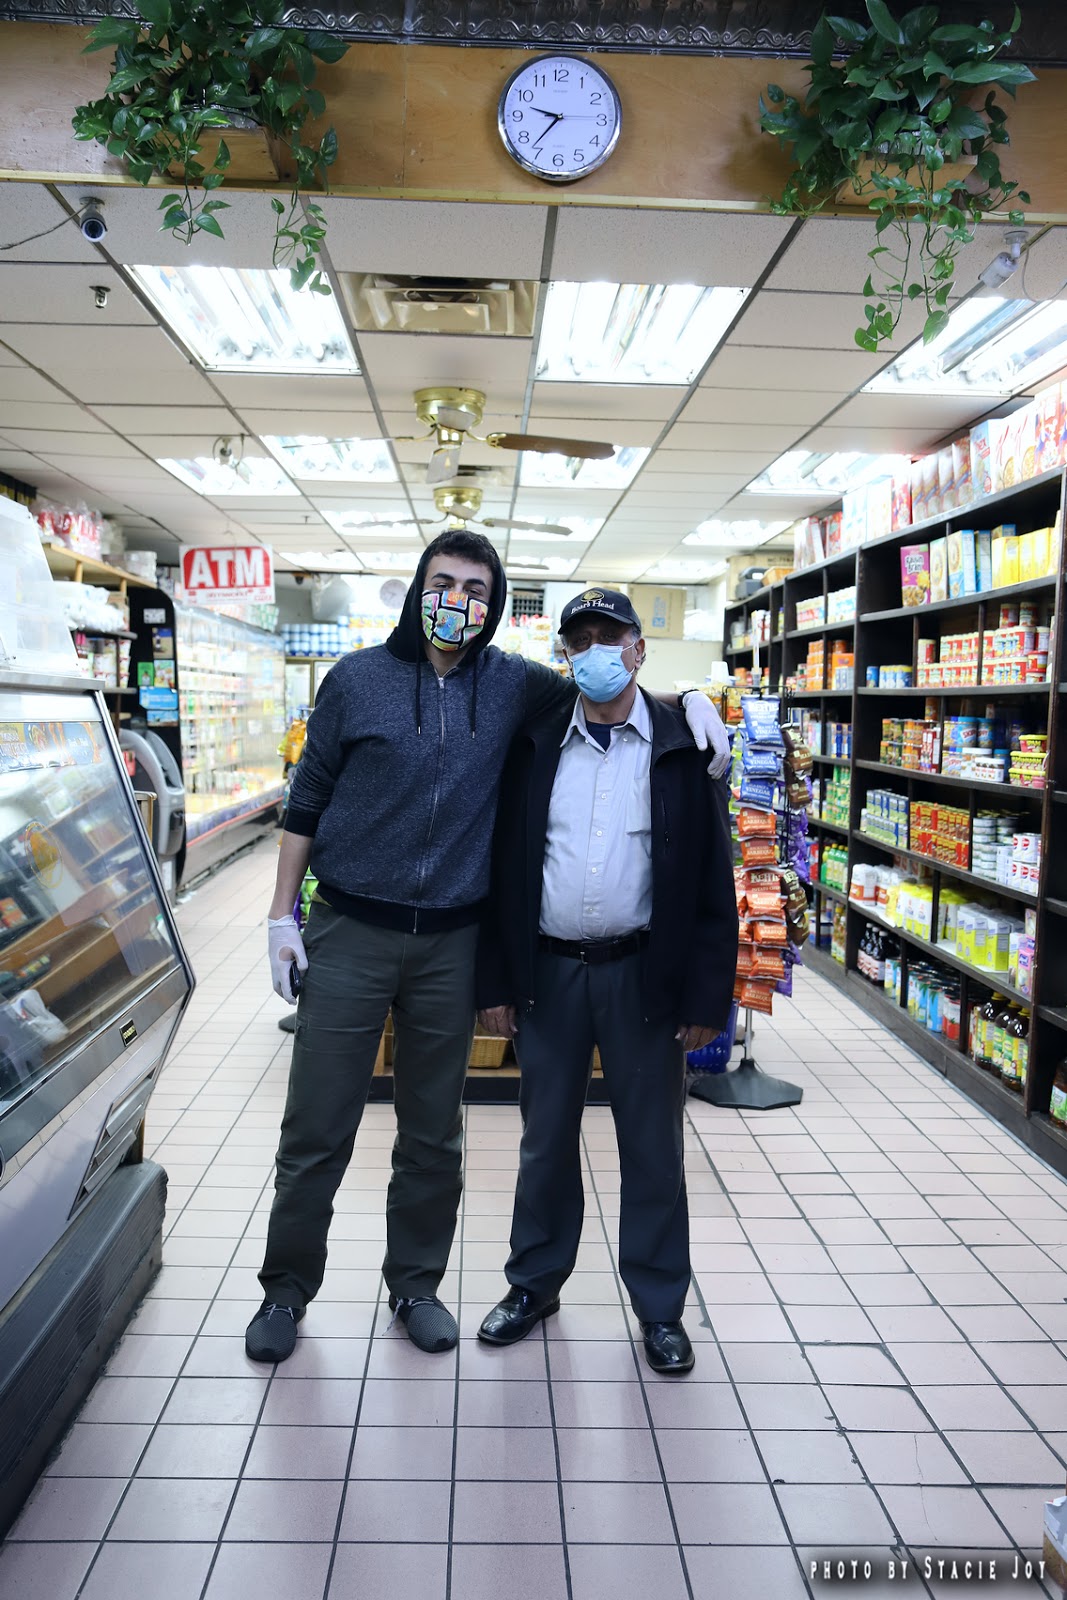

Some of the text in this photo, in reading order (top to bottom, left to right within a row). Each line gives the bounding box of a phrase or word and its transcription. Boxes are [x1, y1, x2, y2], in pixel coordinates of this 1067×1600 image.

[533, 75, 546, 87] 11
[554, 69, 569, 82] 12
[580, 76, 584, 89] 1
[518, 89, 534, 102] 10
[590, 92, 602, 105] 2
[512, 110, 523, 122] 9
[596, 113, 607, 126] 3
[518, 131, 530, 144] 8
[589, 135, 600, 147] 4
[532, 147, 543, 160] 7
[552, 154, 564, 166] 6
[573, 149, 585, 162] 5
[188, 549, 264, 587] ATM
[592, 600, 614, 610] Head
